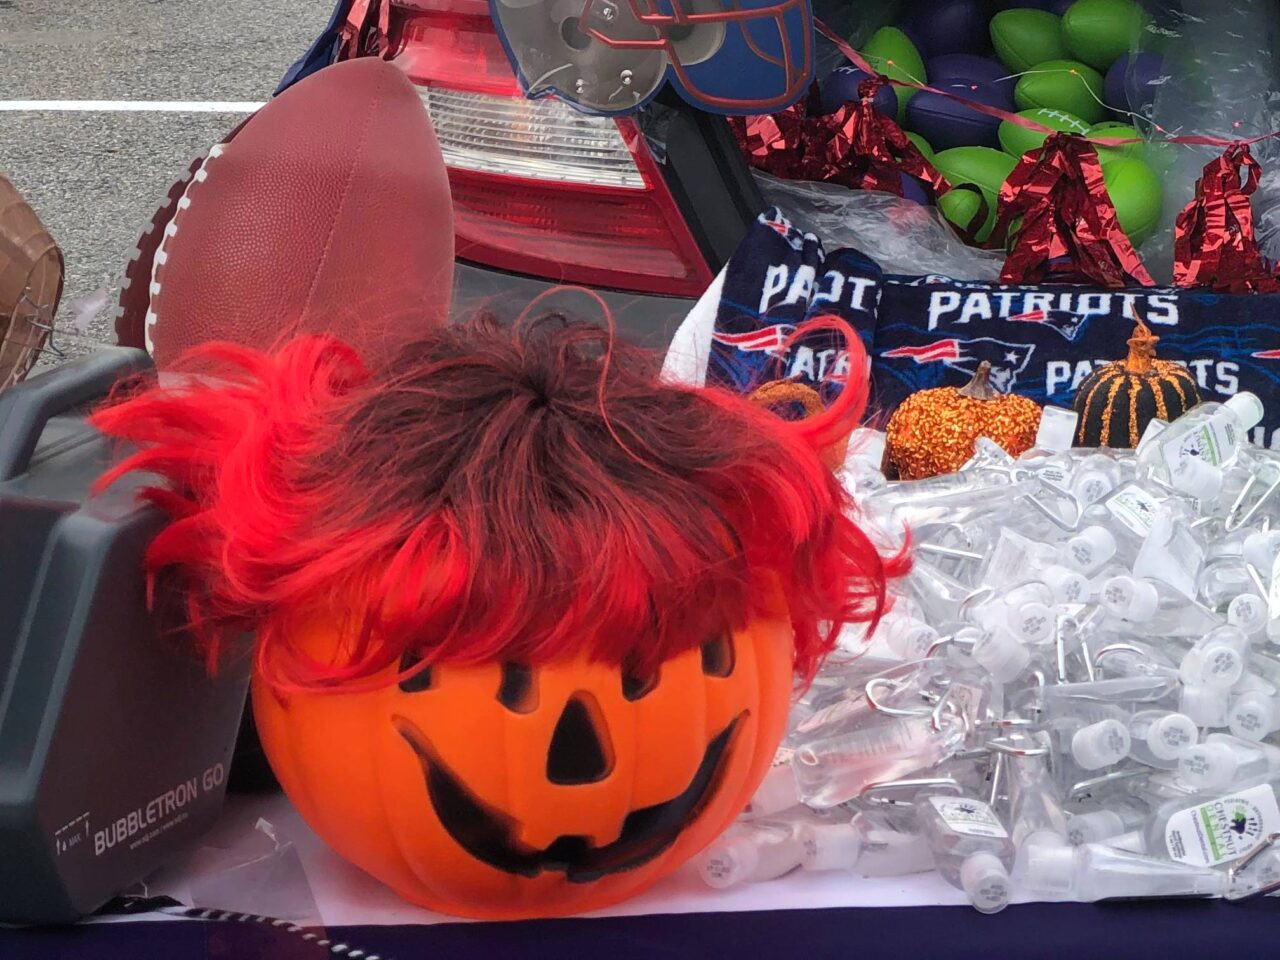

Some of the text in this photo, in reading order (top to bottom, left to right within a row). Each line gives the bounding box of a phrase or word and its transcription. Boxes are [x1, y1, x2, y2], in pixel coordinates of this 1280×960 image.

[928, 291, 1179, 331] PATRIOTS
[94, 762, 224, 856] BUBBLETRON GO
[1214, 801, 1237, 856] CHESTNUT
